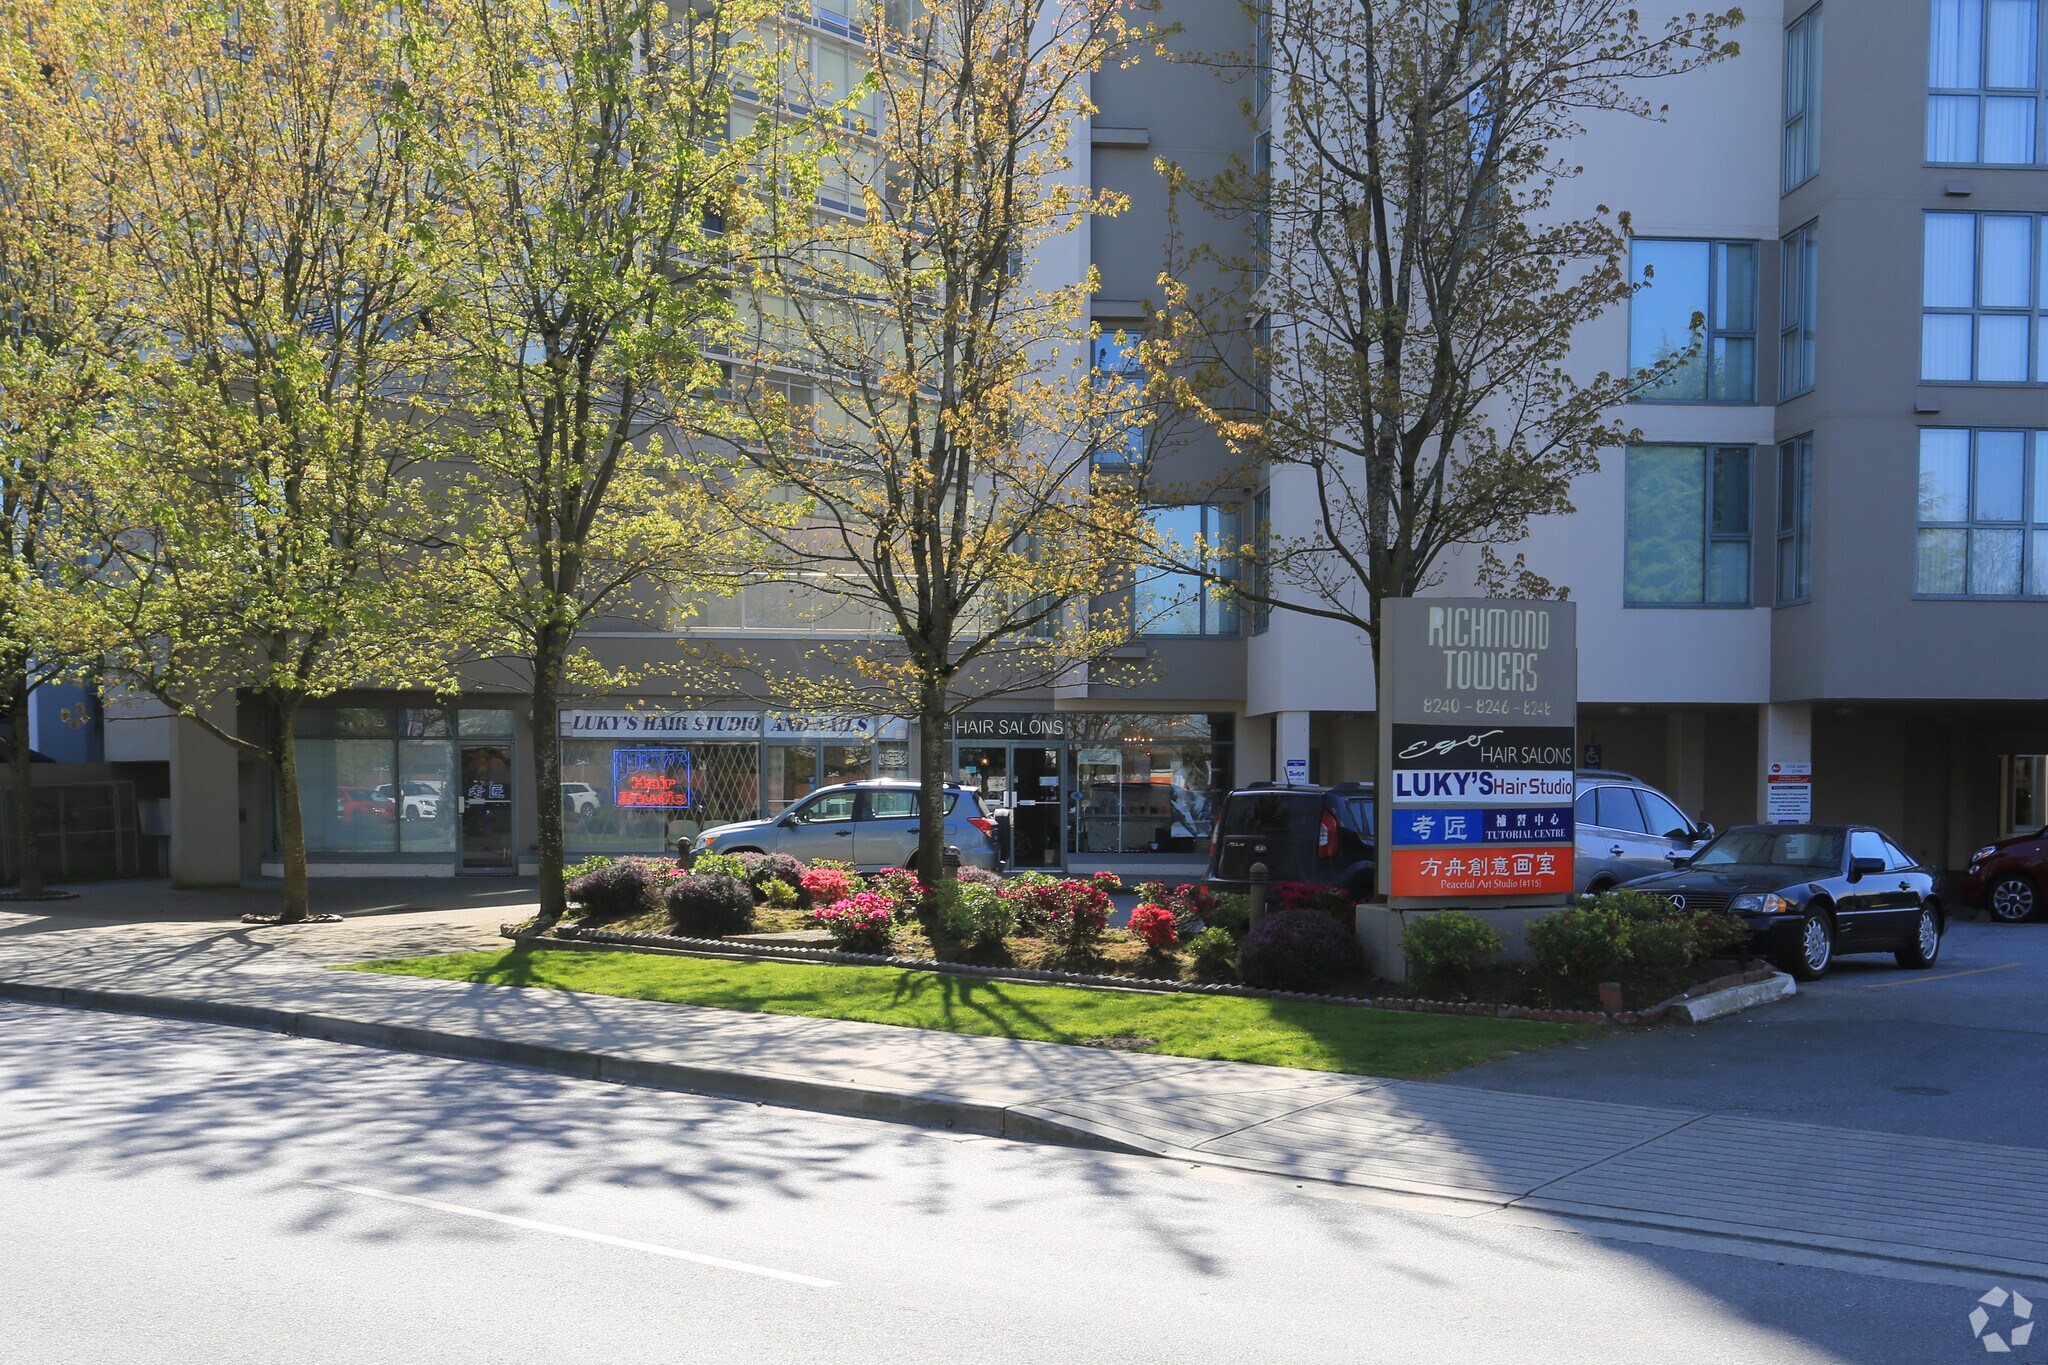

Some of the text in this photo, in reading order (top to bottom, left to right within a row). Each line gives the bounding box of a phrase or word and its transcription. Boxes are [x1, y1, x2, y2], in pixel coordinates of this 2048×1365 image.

[1428, 606, 1549, 650] RICHMOND
[1443, 650, 1538, 692] TOWERS
[1423, 698, 1460, 714] 8240
[1476, 699, 1510, 715] 8246
[1523, 701, 1551, 716] 8248
[572, 715, 638, 731] LUKY'S
[643, 715, 688, 731] HAIR
[692, 715, 760, 732] STUDIO
[812, 717, 869, 732] AILS
[956, 719, 1064, 736] HAIR SALONS
[1481, 746, 1572, 764] HAIR SALONS
[631, 774, 676, 790] Hair
[1396, 771, 1494, 797] LUKY'S
[618, 790, 687, 805] Studio
[1411, 815, 1468, 841] 考匠
[1486, 828, 1566, 840] TUTORIAL CENTRE
[1420, 852, 1556, 877] 方舟創意画室
[1440, 878, 1542, 889] Peaceful Art Studio (#115)
